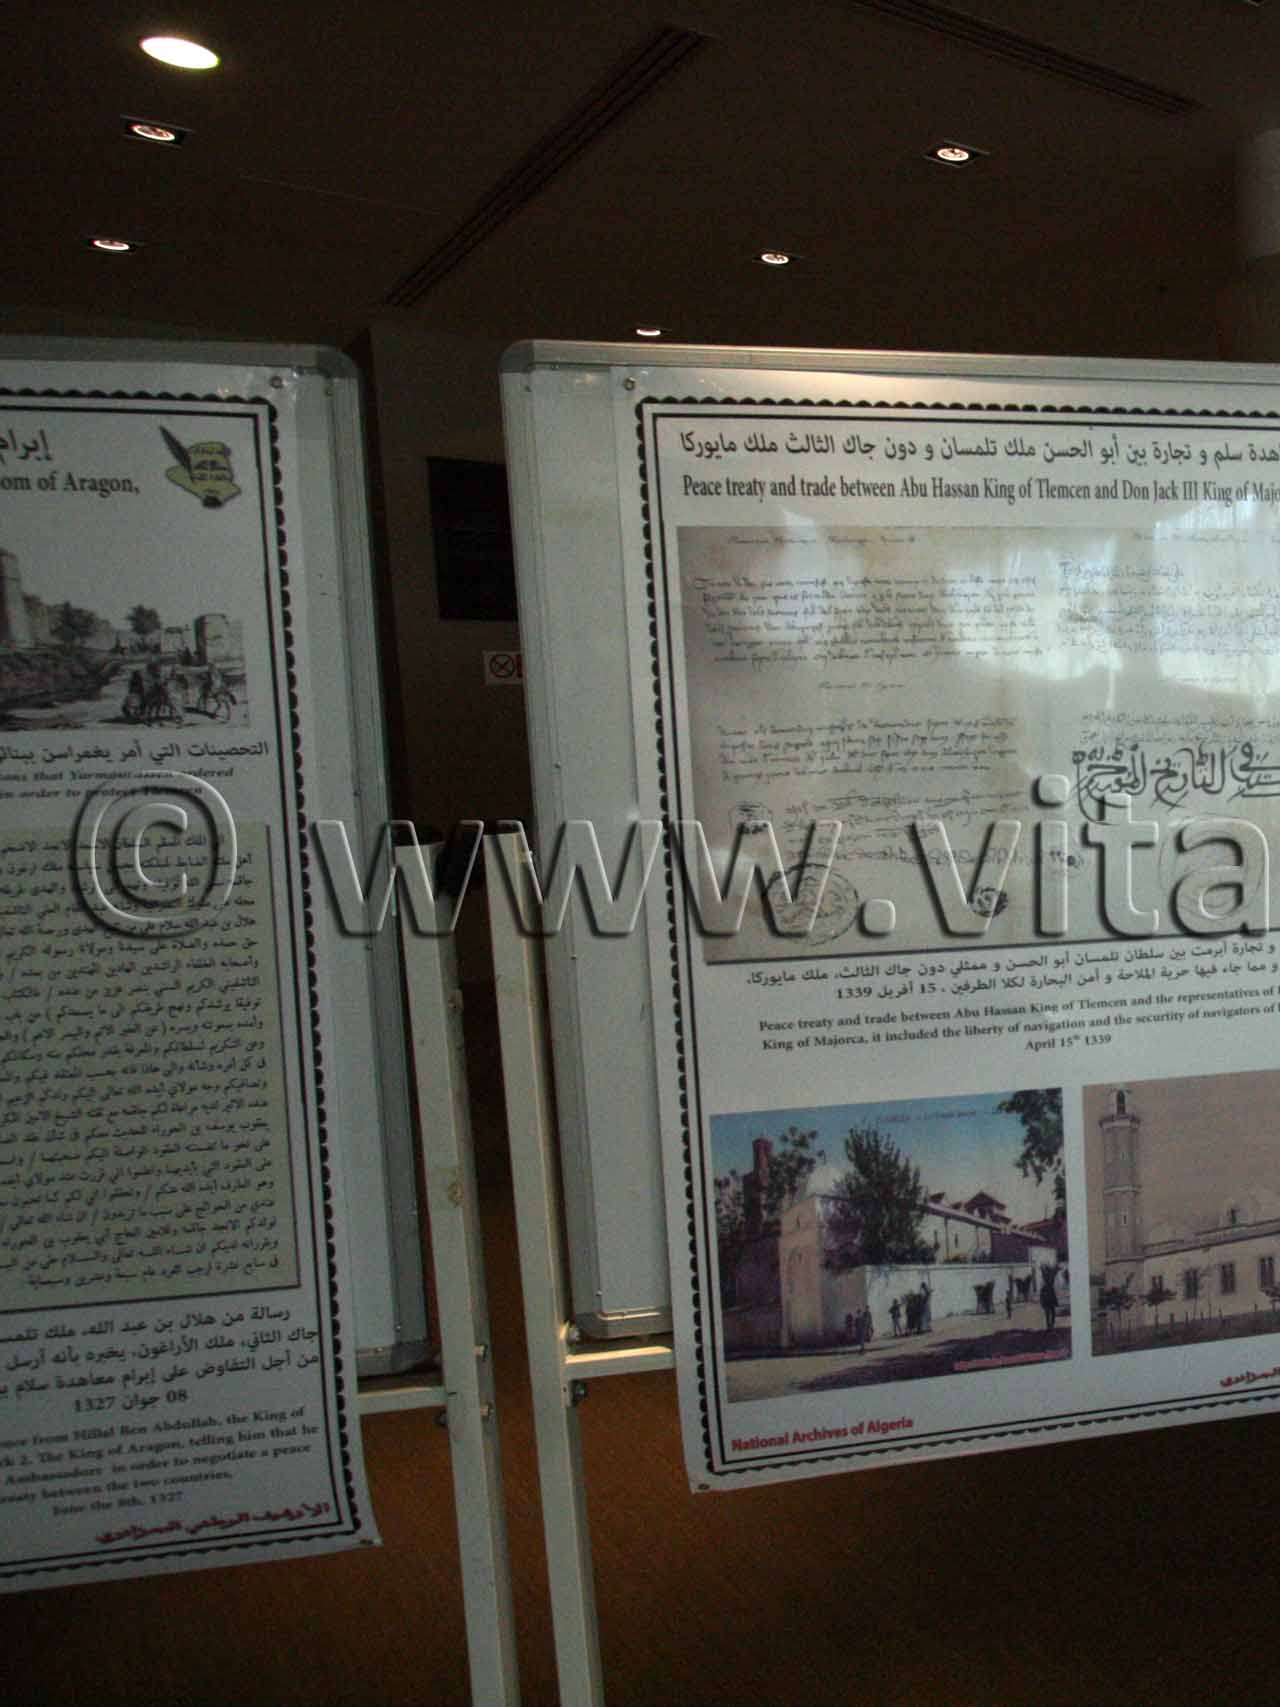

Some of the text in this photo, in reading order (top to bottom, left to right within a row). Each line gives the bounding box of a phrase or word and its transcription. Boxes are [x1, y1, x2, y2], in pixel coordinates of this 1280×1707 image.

[681, 432, 737, 459] مايوركا
[744, 433, 777, 453] ملك
[785, 432, 834, 454] الثالث
[843, 435, 875, 459] جاك
[885, 437, 917, 459] دون
[925, 444, 933, 460] و
[942, 436, 997, 458] تلمسان
[1004, 439, 1035, 457] ملك
[1044, 440, 1092, 462] الحسن
[1100, 433, 1119, 465] أبو
[1153, 442, 1191, 462] تجارة
[1127, 444, 1146, 466] بين
[1200, 449, 1207, 465] و
[1214, 441, 1242, 470] سلم
[37, 471, 139, 498] of Aragon,
[683, 475, 721, 496] Peace
[726, 477, 765, 502] treaty
[770, 475, 796, 497] and
[800, 475, 836, 497] trade
[841, 476, 894, 497] between
[900, 476, 927, 497] Abu
[932, 477, 979, 498] Hassan
[983, 477, 1015, 505] King
[1019, 478, 1033, 499] of
[1035, 478, 1090, 499] Tlemcen
[1094, 481, 1118, 500] and
[1123, 481, 1149, 500] Don
[1153, 481, 1179, 503] Jack
[1183, 482, 1198, 500] III
[1203, 482, 1232, 506] King
[1236, 481, 1250, 501] of
[150, 743, 181, 764] التي
[802, 968, 828, 980] ملك
[837, 986, 872, 999] 1339
[760, 1021, 793, 1031] Peace
[798, 1017, 833, 1031] treaty
[838, 1016, 860, 1027] and
[865, 1013, 897, 1025] trade
[901, 1009, 950, 1022] between
[954, 1007, 979, 1018] Abu
[984, 1004, 1026, 1017] Hassan
[1031, 1001, 1058, 1014] King
[1062, 999, 1074, 1012] of
[1080, 995, 1126, 1010] Tlemcen
[1132, 994, 1152, 1006] and
[1156, 992, 1173, 1005] the
[1178, 987, 1259, 1004] representatives
[1264, 985, 1274, 996] of
[763, 1038, 793, 1051] King
[798, 1036, 810, 1047] of
[886, 1028, 938, 1041] included
[943, 1027, 960, 1038] the
[965, 1023, 1004, 1038] liberty
[1008, 1022, 1020, 1033] of
[1024, 1018, 1086, 1034] navigation
[1090, 1015, 1110, 1027] and
[1115, 1013, 1131, 1025] the
[1188, 1007, 1198, 1019] of
[1203, 1004, 1259, 1020] navigators
[1264, 1002, 1274, 1014] of
[1025, 1033, 1111, 1051] April 1339
[74, 1397, 114, 1412] 1327
[167, 1390, 187, 1402] 08
[732, 1417, 913, 1451] National Archives of Algeria
